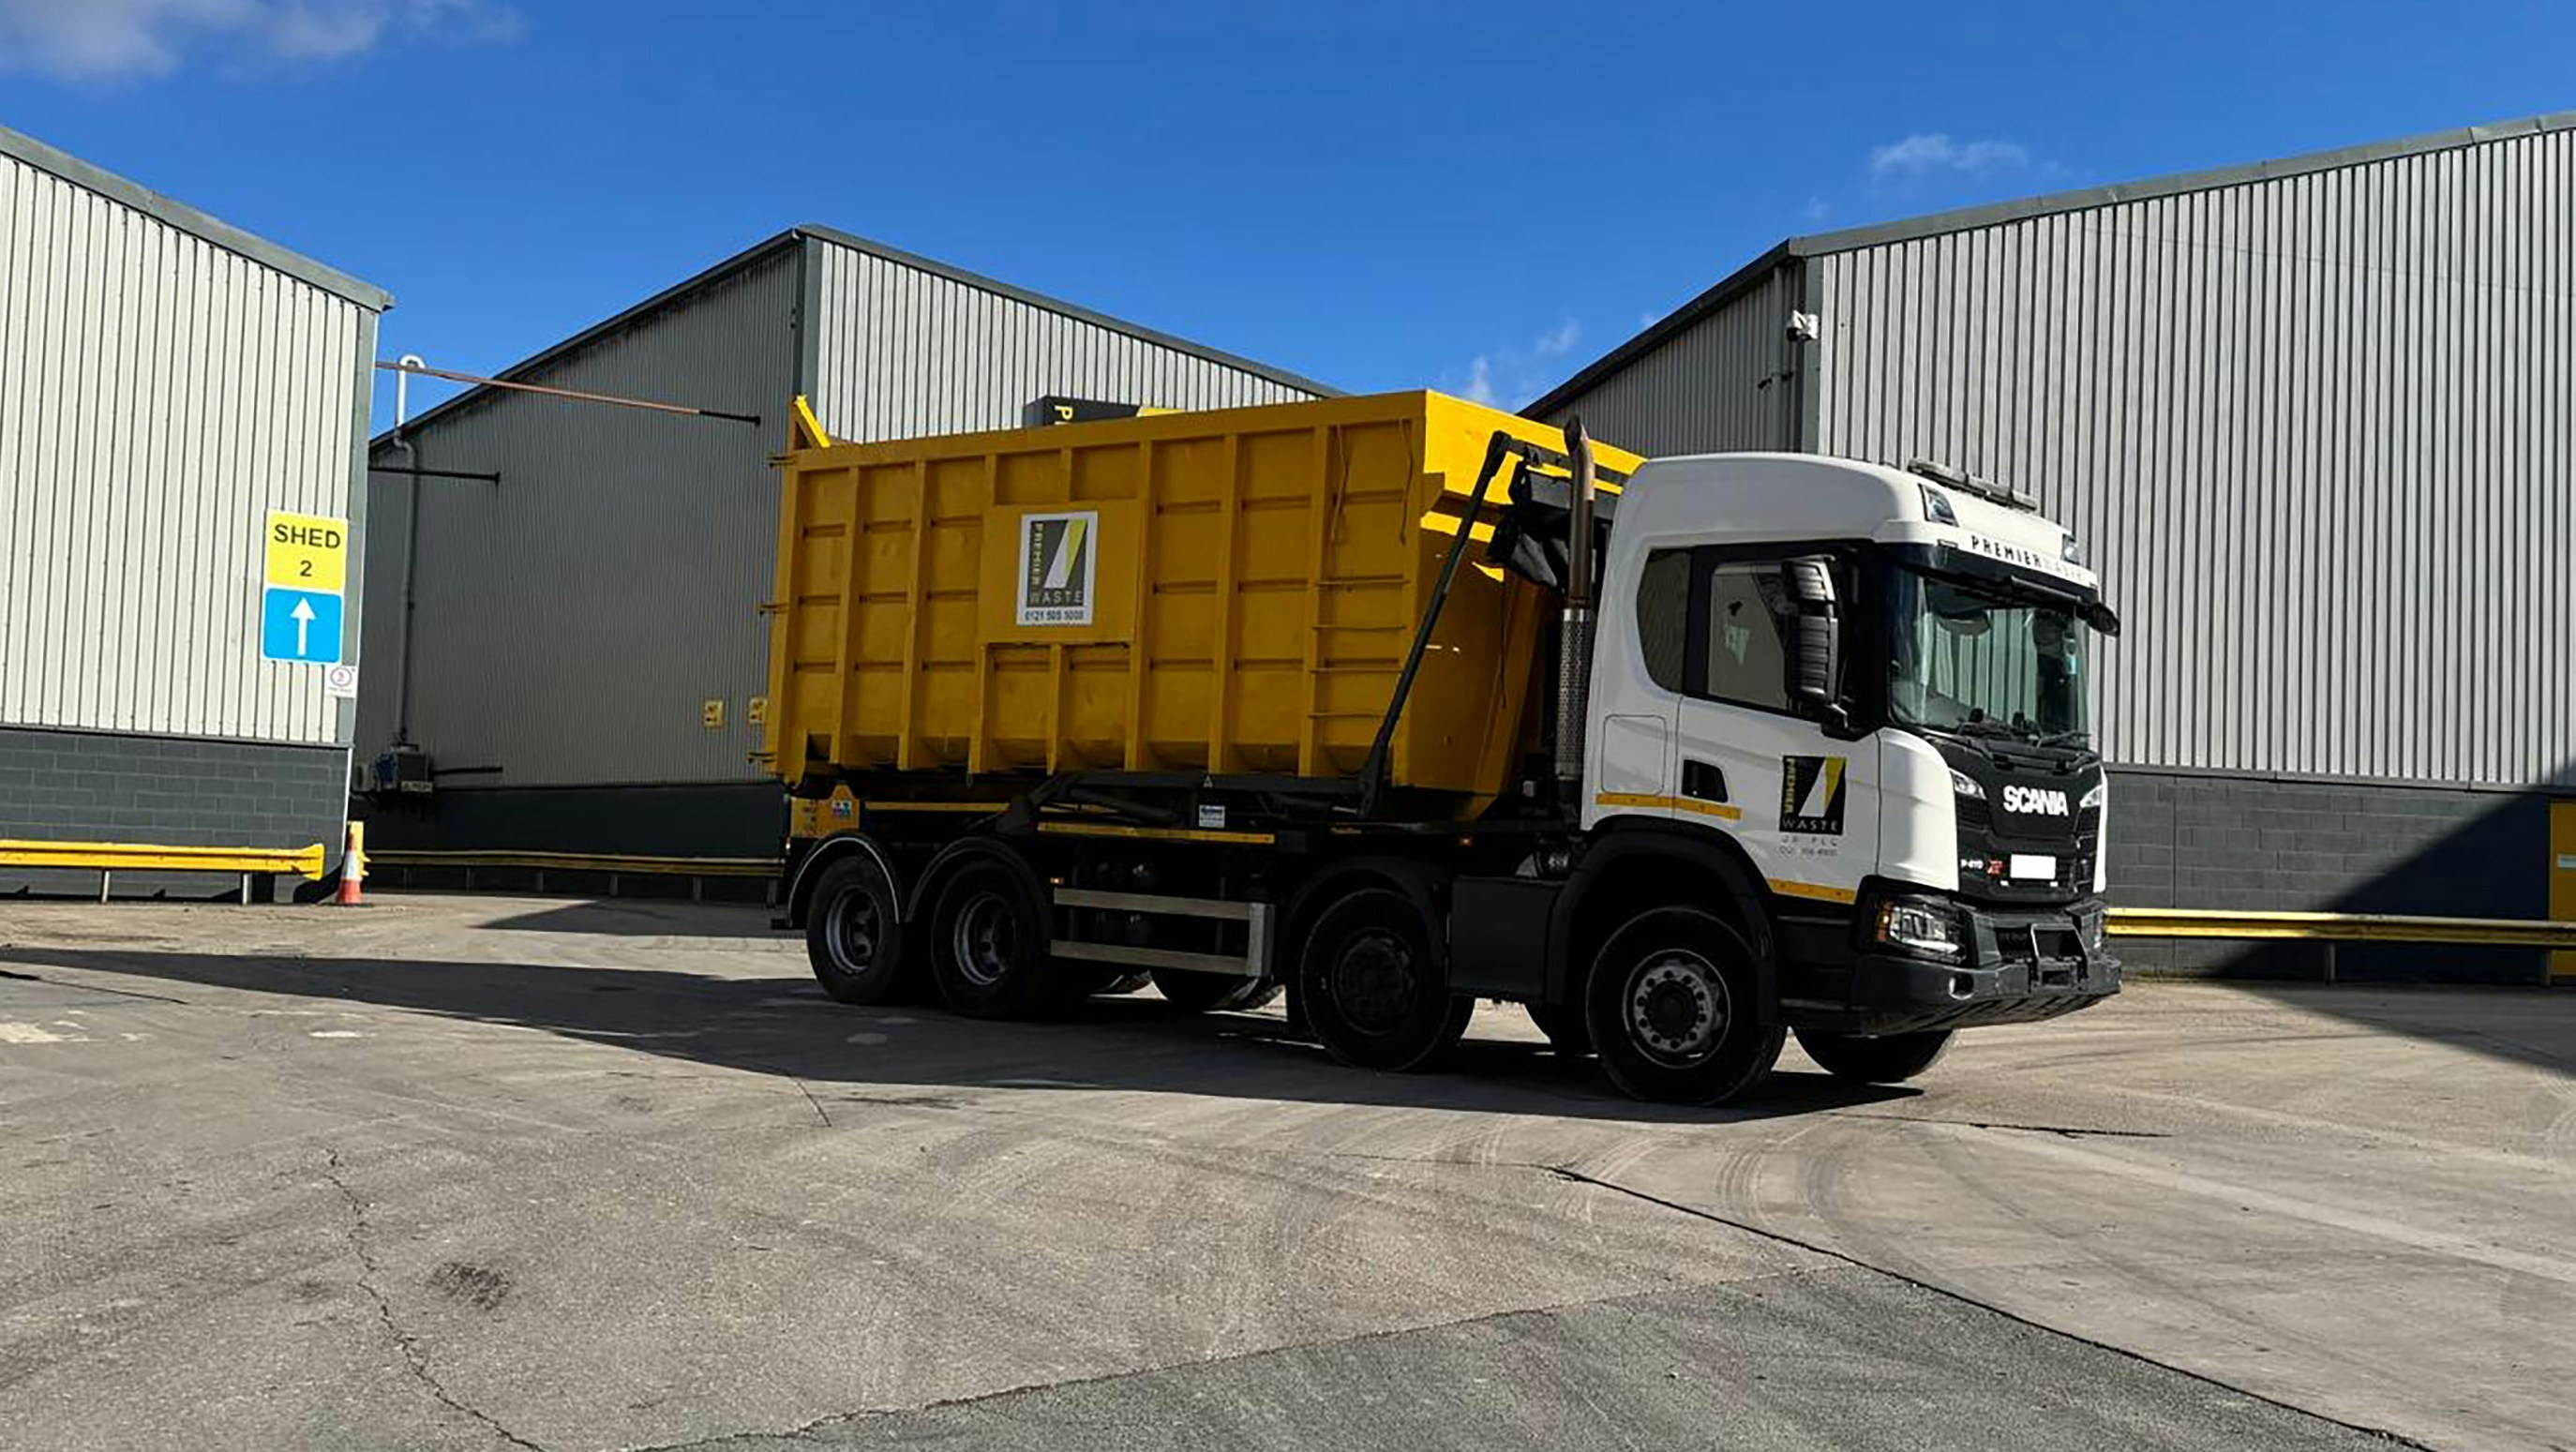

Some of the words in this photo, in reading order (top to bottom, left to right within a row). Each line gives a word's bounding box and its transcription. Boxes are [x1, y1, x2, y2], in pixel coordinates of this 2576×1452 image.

[274, 523, 341, 549] SHED
[1970, 534, 2043, 568] PREMIER
[300, 560, 313, 577] 2
[1030, 590, 1083, 605] WASTE
[2003, 785, 2069, 816] SCANIA
[1782, 817, 1839, 831] WASTE
